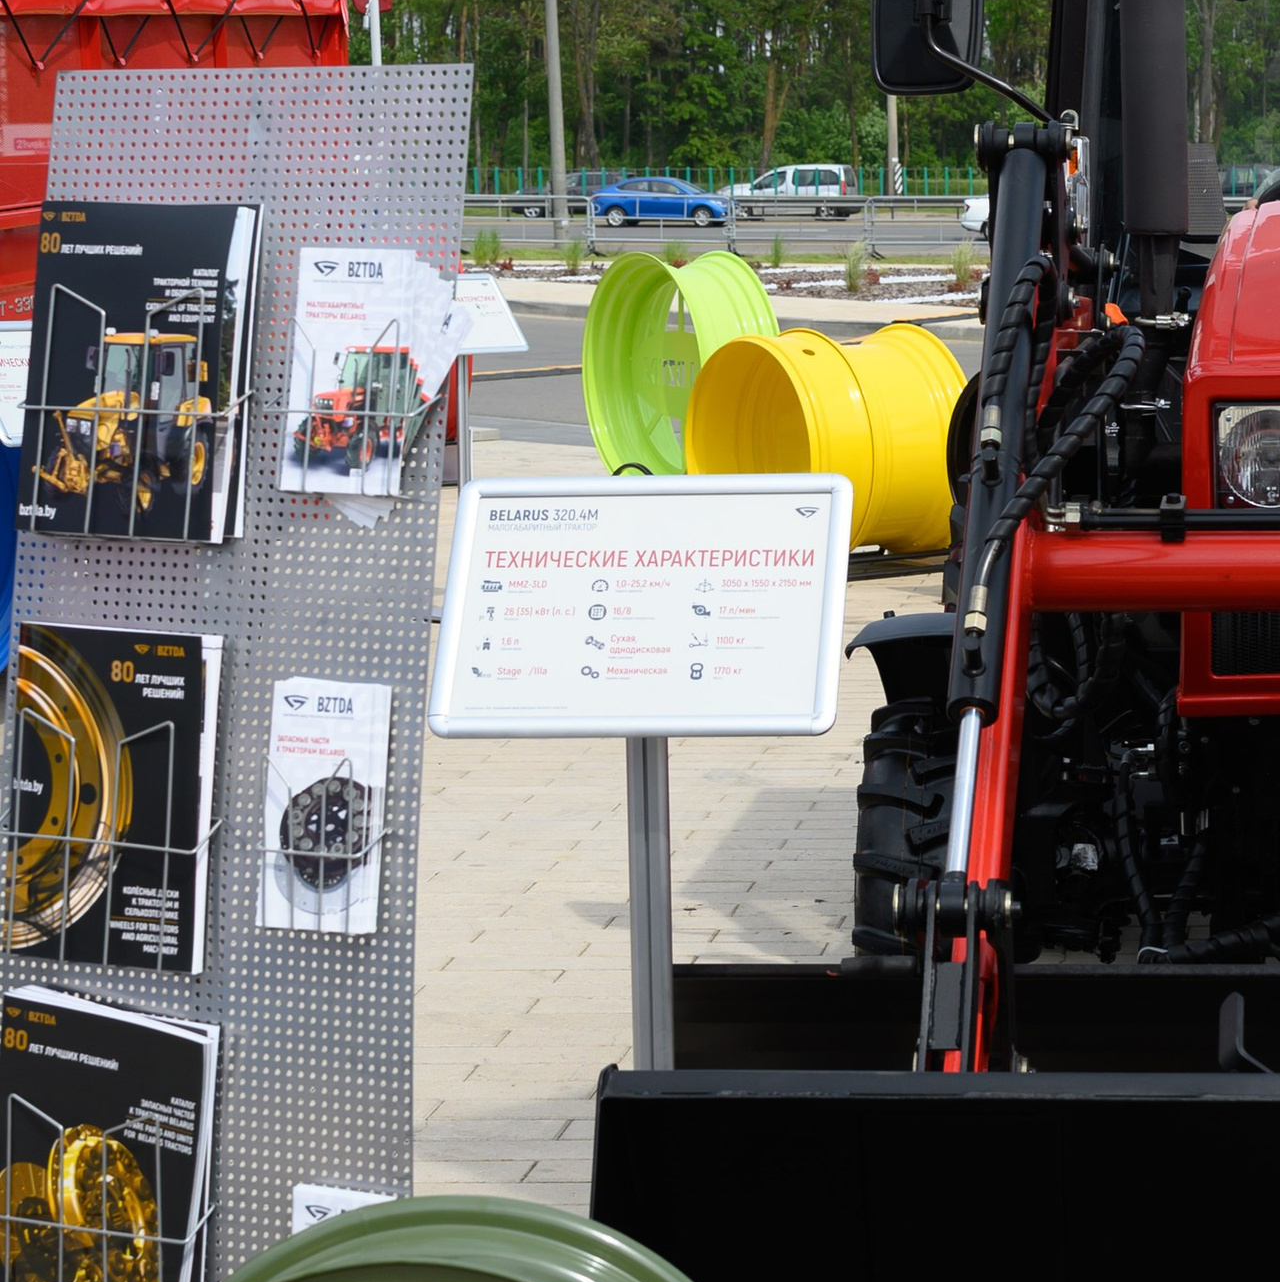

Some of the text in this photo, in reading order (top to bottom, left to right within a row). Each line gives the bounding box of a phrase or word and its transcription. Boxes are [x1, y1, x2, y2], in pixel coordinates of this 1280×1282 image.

[61, 211, 86, 222] BZTDA
[40, 232, 61, 253] 80
[60, 244, 74, 254] ЛЕТ
[74, 244, 104, 254] ЛУЧШИХ
[193, 269, 219, 277] КАТАЛОГ
[347, 261, 383, 279] BZTDA
[153, 277, 218, 287] ТРАКТОРНОЙ ТЕХНИКИ
[186, 304, 216, 313] TRACORS
[306, 301, 365, 309] МАЛОГАБАРИТНЫЕ
[181, 314, 215, 323] EQUIPENT
[490, 509, 599, 521] BELARUS 320.4M
[487, 522, 597, 531] МАЛОГАБАРИТНЫЙ ТРАКТОР
[485, 549, 815, 568] ТЕХНИЧЕСКИЕ ХАРАКТЕРИСТИКИ
[508, 580, 547, 588] MMZ-3LD
[721, 579, 742, 587] 3050
[751, 579, 769, 587] 1550
[779, 578, 797, 587] 2150
[504, 607, 515, 615] 26
[613, 607, 632, 616] 16/8
[719, 606, 727, 614] 17
[716, 636, 733, 644] 1100
[157, 645, 185, 657] BZTDA
[609, 647, 671, 655] однодисковая
[111, 660, 185, 686] 80 ЛЕТ ЛУЧШИХ
[497, 667, 522, 676] Stage
[606, 667, 668, 675] Механическая
[714, 667, 731, 675] 1770
[317, 697, 353, 714] BZTDA
[277, 735, 330, 744] ЗАПАСНЫЕ ЧАСТИ
[282, 746, 317, 754] ТРАКТОРАМ
[157, 889, 179, 898] ДСКИ
[109, 921, 179, 934] WHEELS FOR TRATORS
[122, 932, 135, 941] AND
[28, 1011, 57, 1026] BZTDA
[4, 1027, 28, 1051] 80
[28, 1043, 45, 1054] ЛЕТ
[44, 1046, 79, 1061] ЛУЧШИХ
[170, 1096, 197, 1110] КАТАЛОГ
[141, 1098, 195, 1121] ЗАПАСНЫХ ЧАСТЕЙ
[124, 1129, 192, 1155] FOR BELARS TRACTORS
[176, 1133, 193, 1145] UNITS
